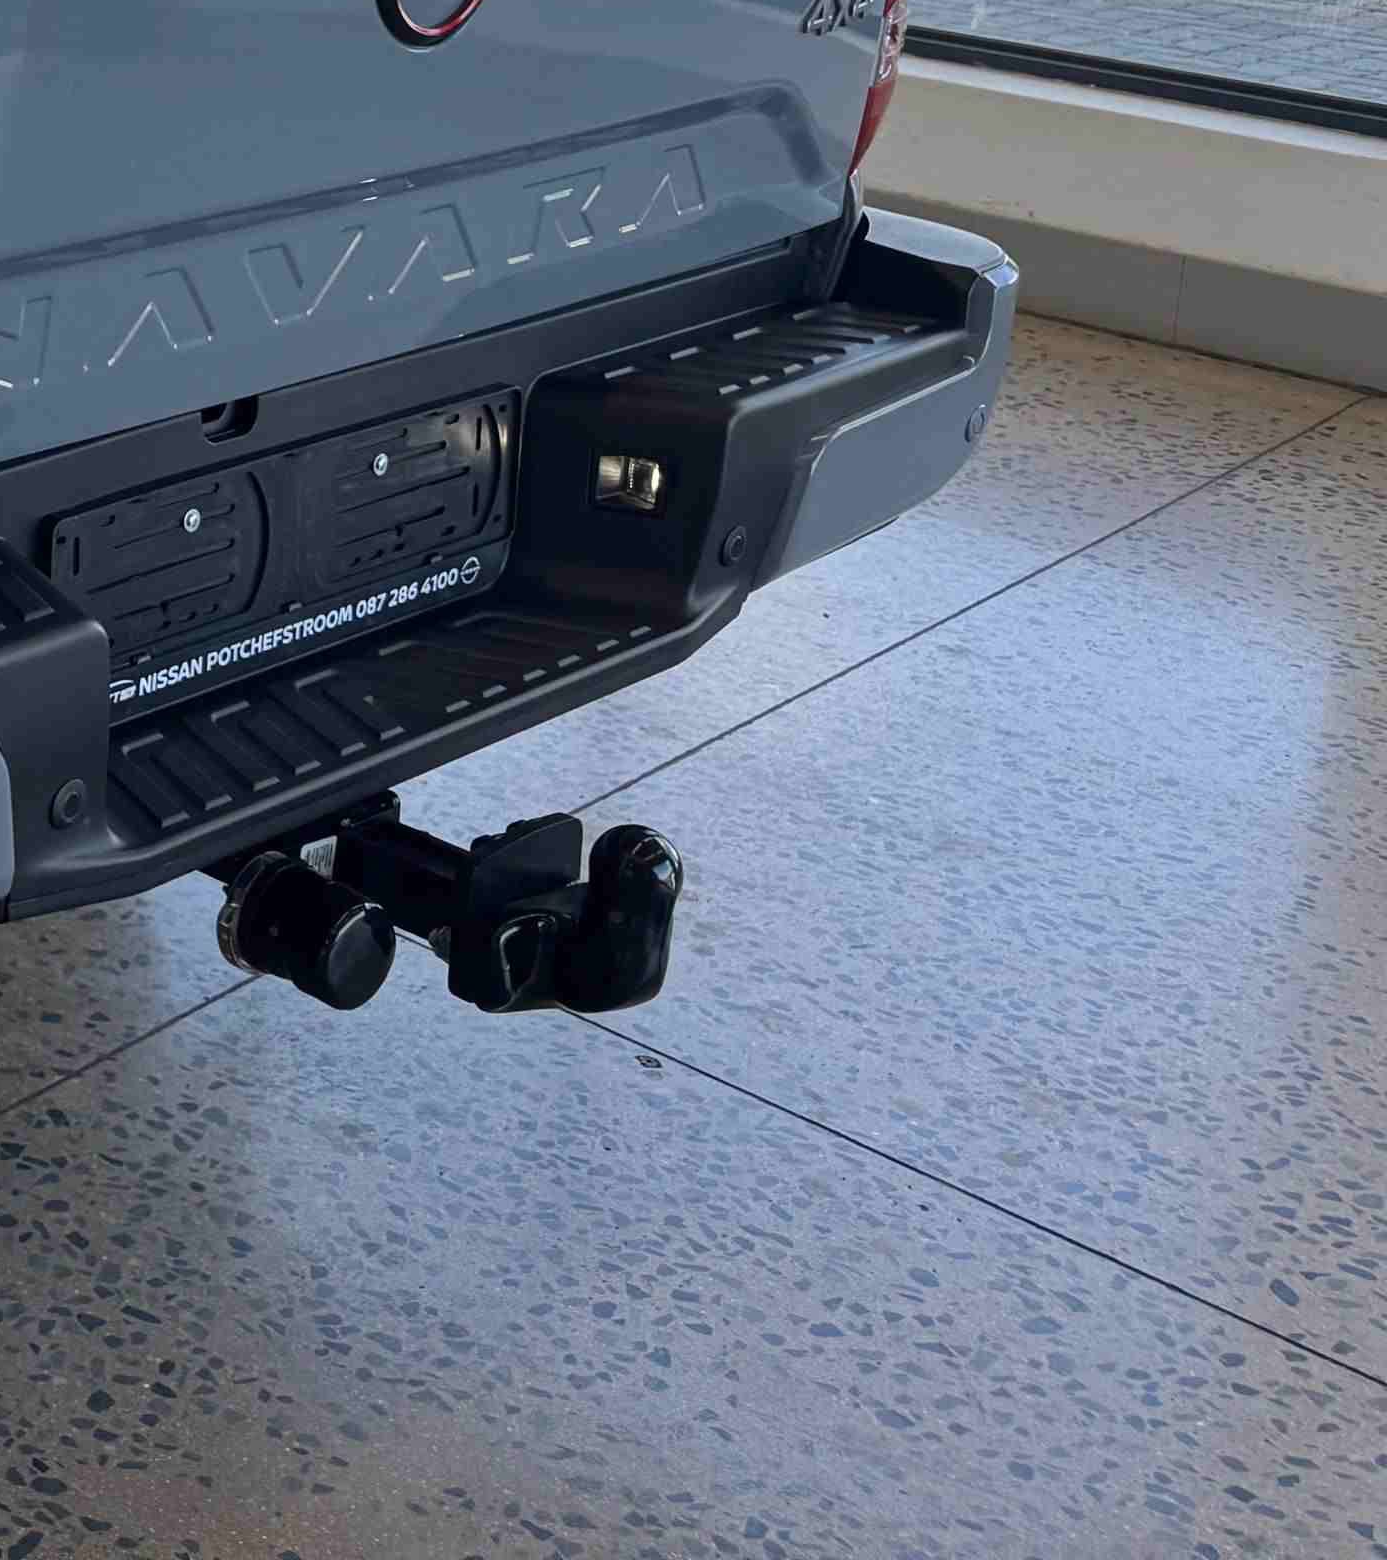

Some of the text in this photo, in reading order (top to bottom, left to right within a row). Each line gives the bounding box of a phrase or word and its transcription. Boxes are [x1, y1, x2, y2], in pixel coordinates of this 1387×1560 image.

[138, 656, 203, 696] NISSAN
[206, 603, 354, 671] POTCHEFSTROOM
[355, 592, 387, 619] 087
[388, 581, 418, 608] 286
[420, 567, 459, 595] 4100
